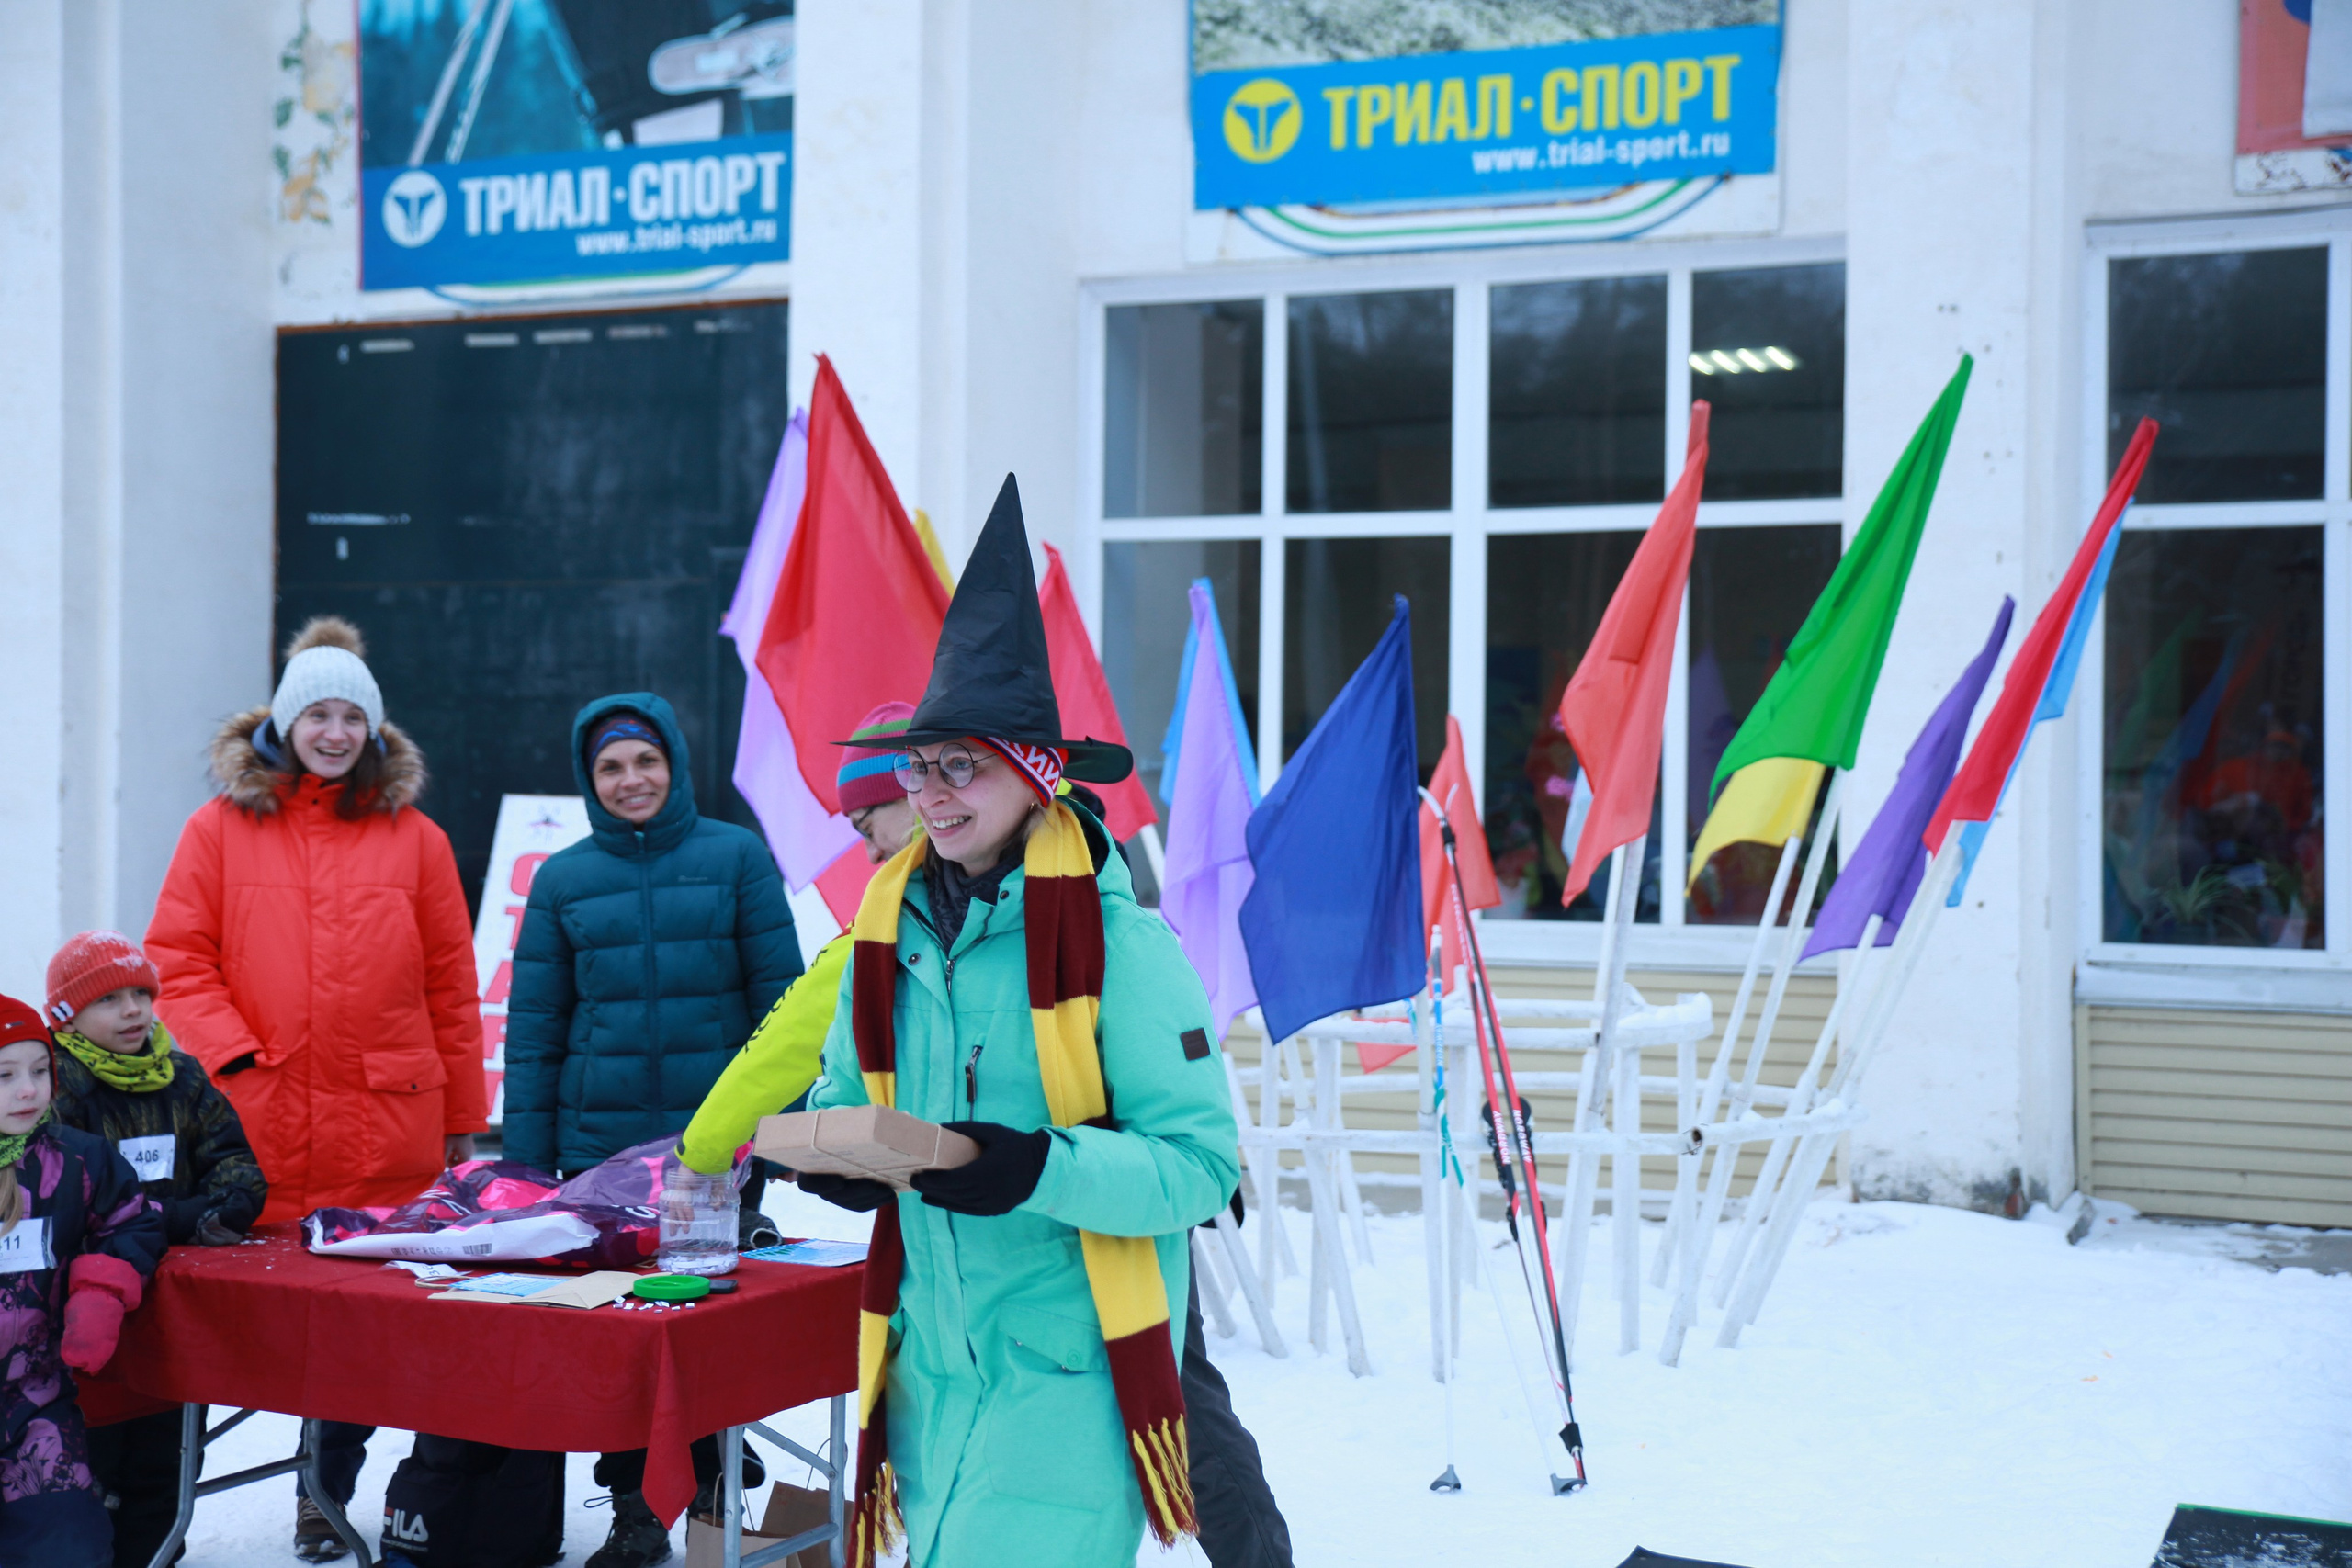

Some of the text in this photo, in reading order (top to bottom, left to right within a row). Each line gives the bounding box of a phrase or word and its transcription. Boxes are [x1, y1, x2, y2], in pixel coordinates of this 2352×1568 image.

[1472, 130, 1730, 173] www.trial-sport.ru
[575, 219, 776, 256] www.trial-sport.ru
[135, 1149, 159, 1163] 406
[1493, 1111, 1511, 1165] NORDWAY
[1513, 1109, 1532, 1164] NORDWAY
[0, 1235, 20, 1250] 11
